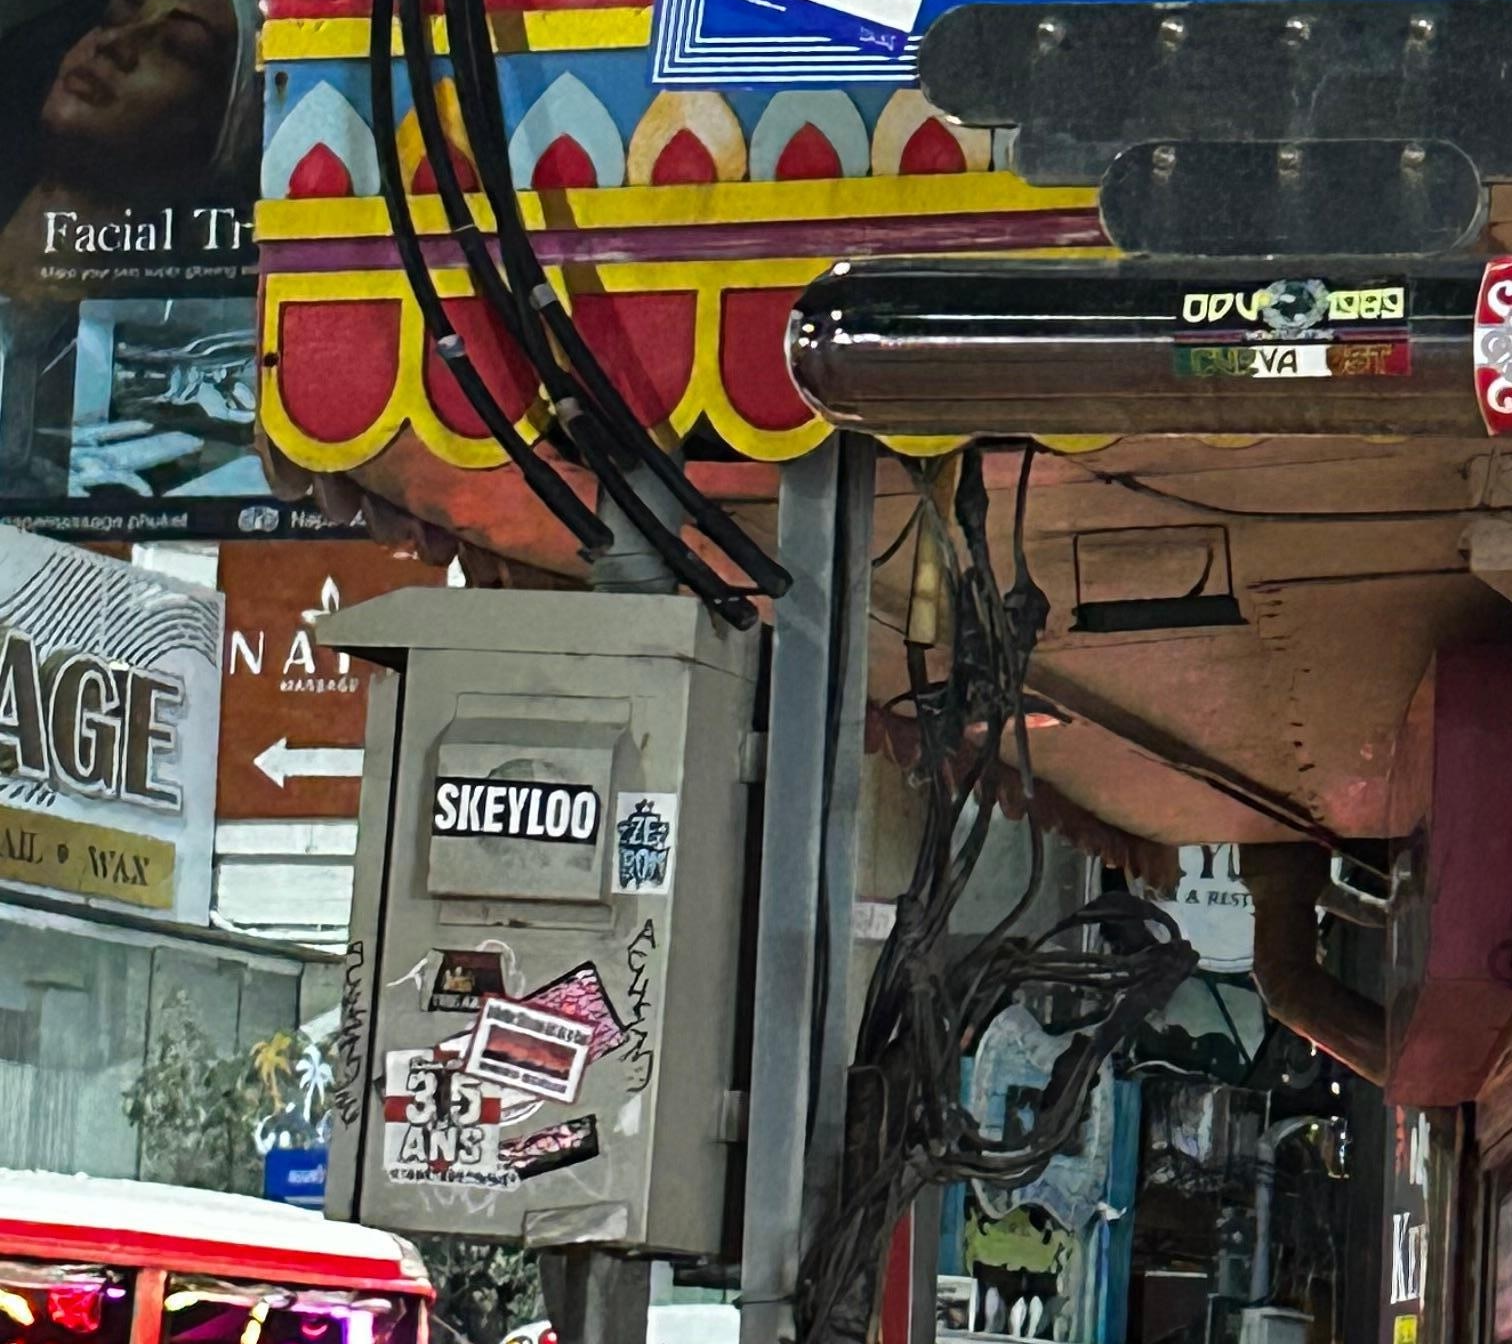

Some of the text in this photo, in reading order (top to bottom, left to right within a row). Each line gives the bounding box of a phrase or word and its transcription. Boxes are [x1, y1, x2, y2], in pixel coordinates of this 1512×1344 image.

[44, 207, 173, 254] Facial
[435, 783, 597, 839] SKEYLOO
[88, 844, 150, 886] WAX
[406, 1068, 484, 1127] 35
[401, 1124, 484, 1164] ANS
